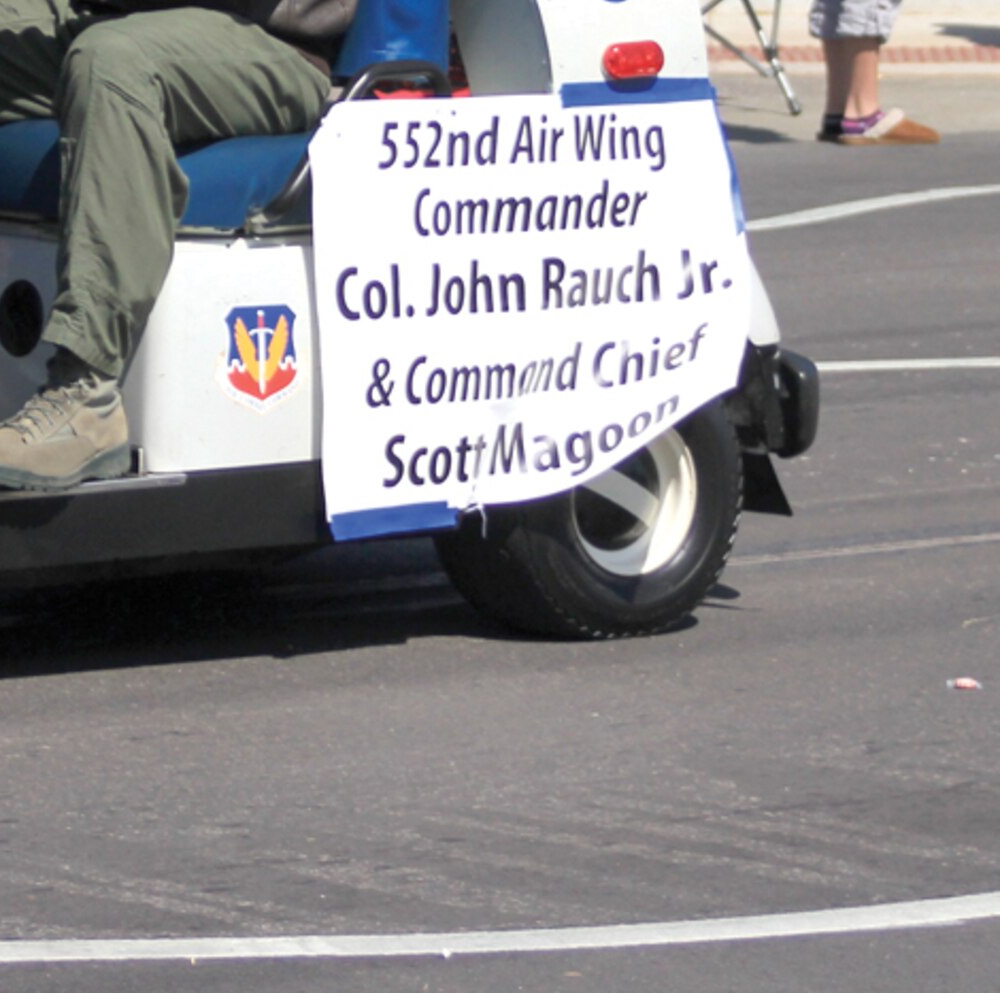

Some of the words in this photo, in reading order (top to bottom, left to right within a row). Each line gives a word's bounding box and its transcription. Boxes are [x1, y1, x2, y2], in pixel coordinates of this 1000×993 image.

[378, 115, 499, 170] 552nd
[510, 114, 564, 164] Air
[575, 113, 667, 172] Wing
[413, 179, 648, 237] Commander
[335, 262, 415, 322] Col.
[425, 259, 526, 317] John
[541, 249, 661, 310] Rauch
[676, 248, 733, 300] Jr.
[366, 357, 395, 409] &
[405, 341, 582, 406] Command
[592, 322, 709, 389] Chief
[383, 433, 487, 488] Scott
[488, 394, 680, 477] Magoon
